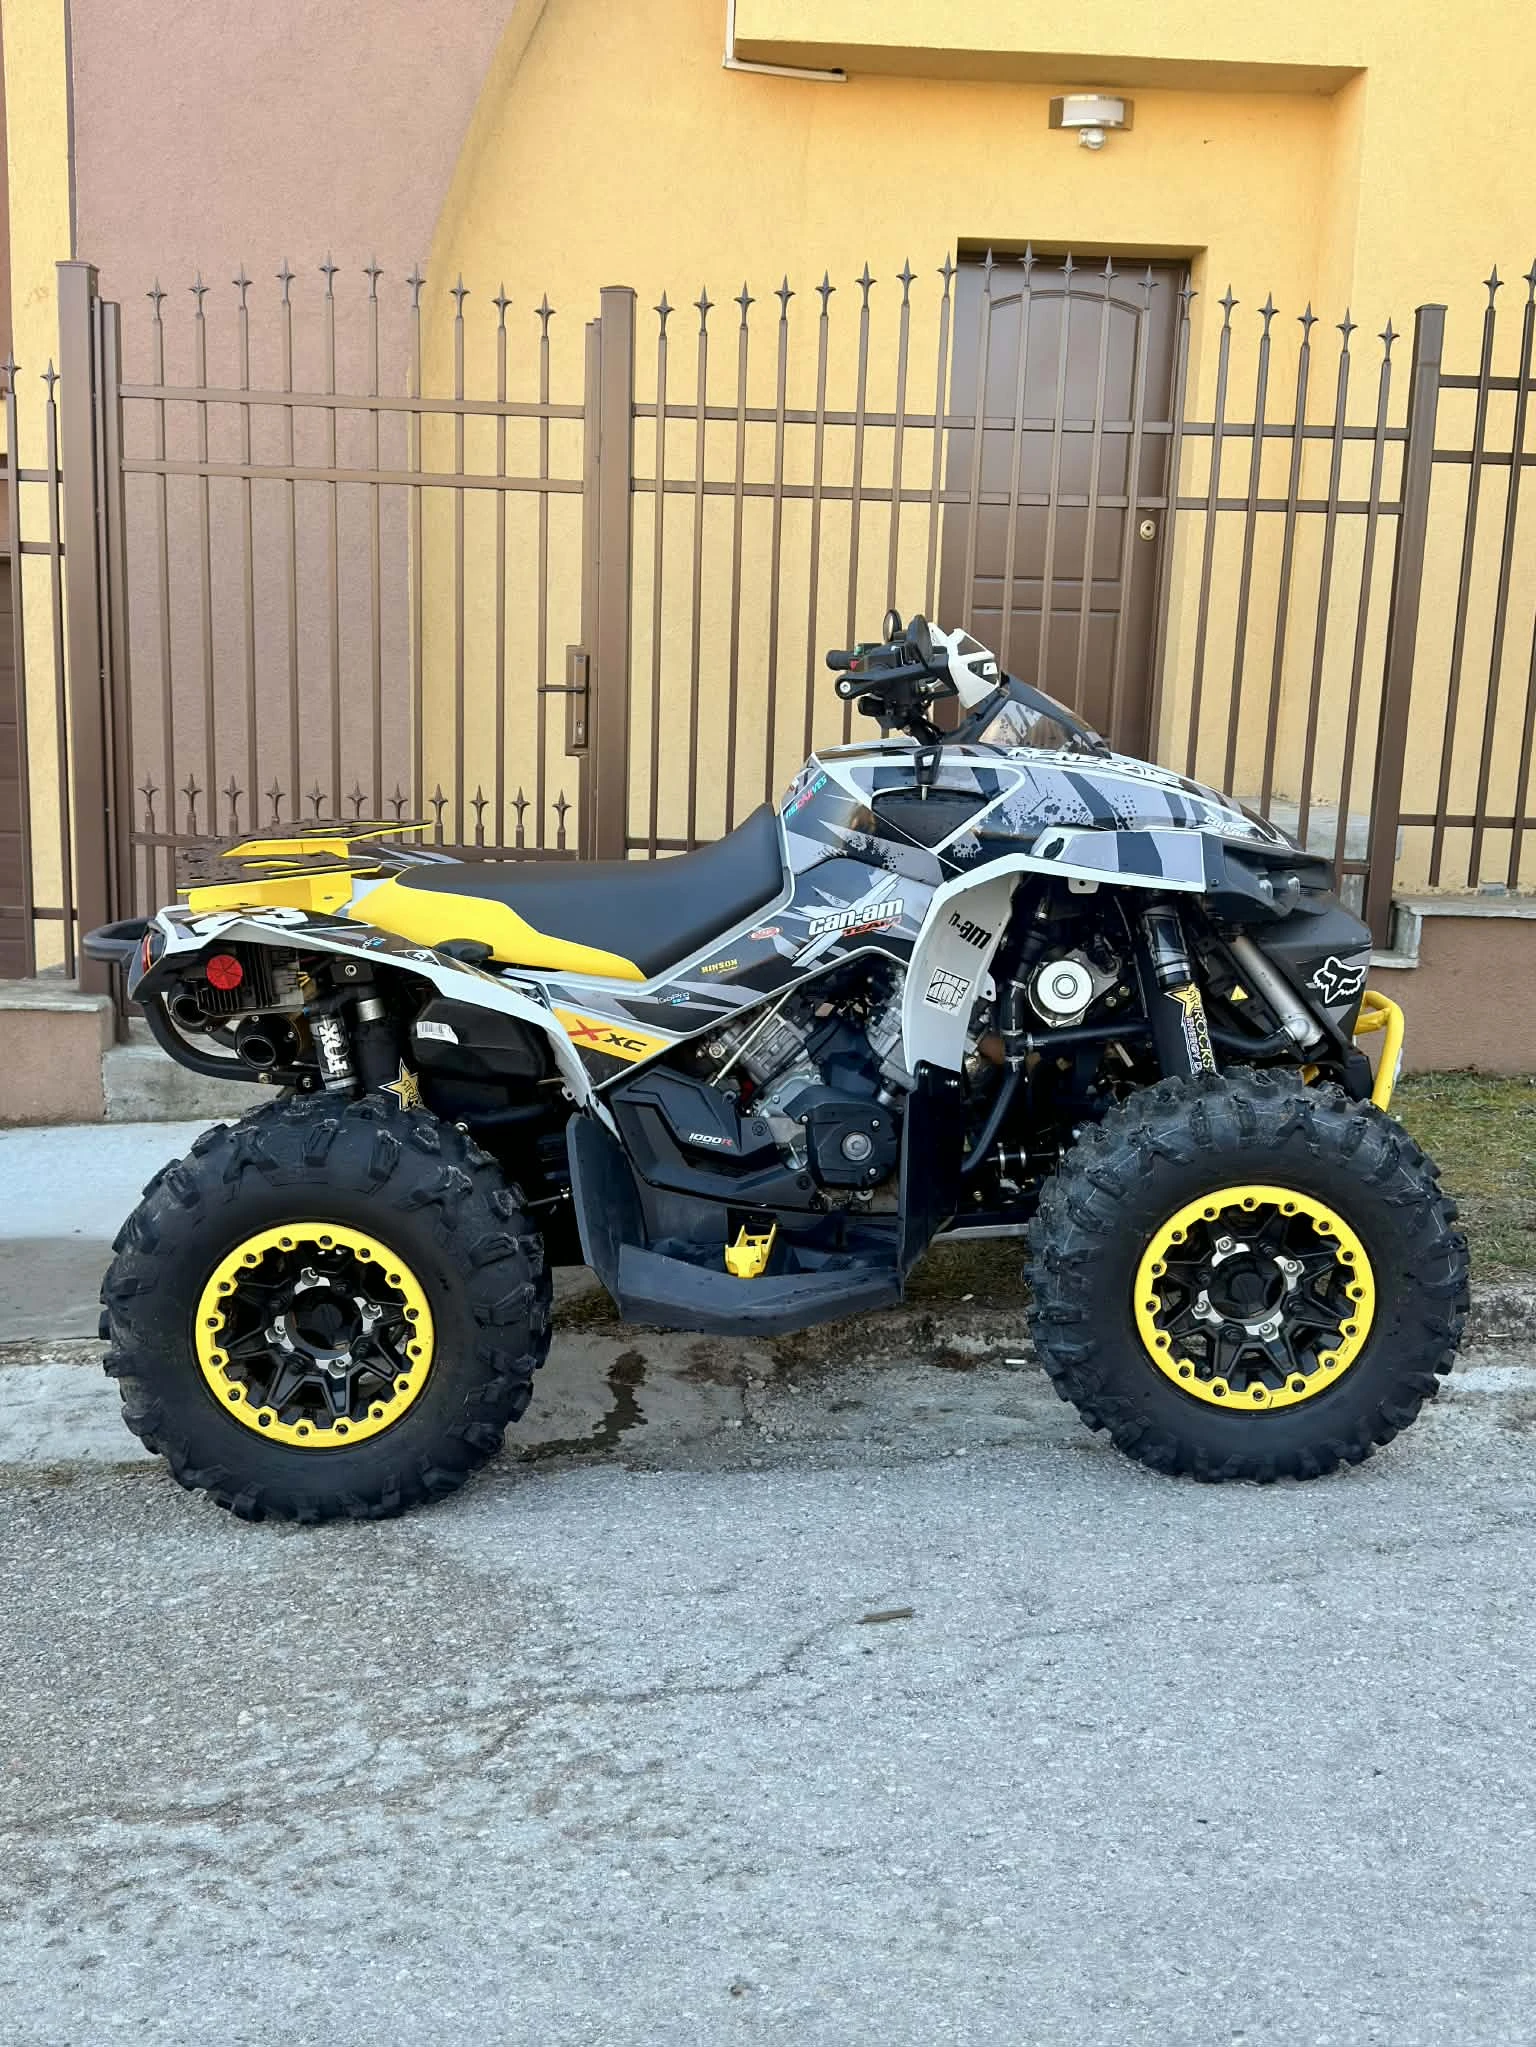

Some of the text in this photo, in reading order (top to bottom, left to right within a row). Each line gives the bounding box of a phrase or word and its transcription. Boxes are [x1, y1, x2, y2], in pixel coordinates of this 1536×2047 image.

[807, 898, 903, 936] can-am
[318, 1020, 348, 1074] FOX
[688, 1132, 733, 1147] 1000R
